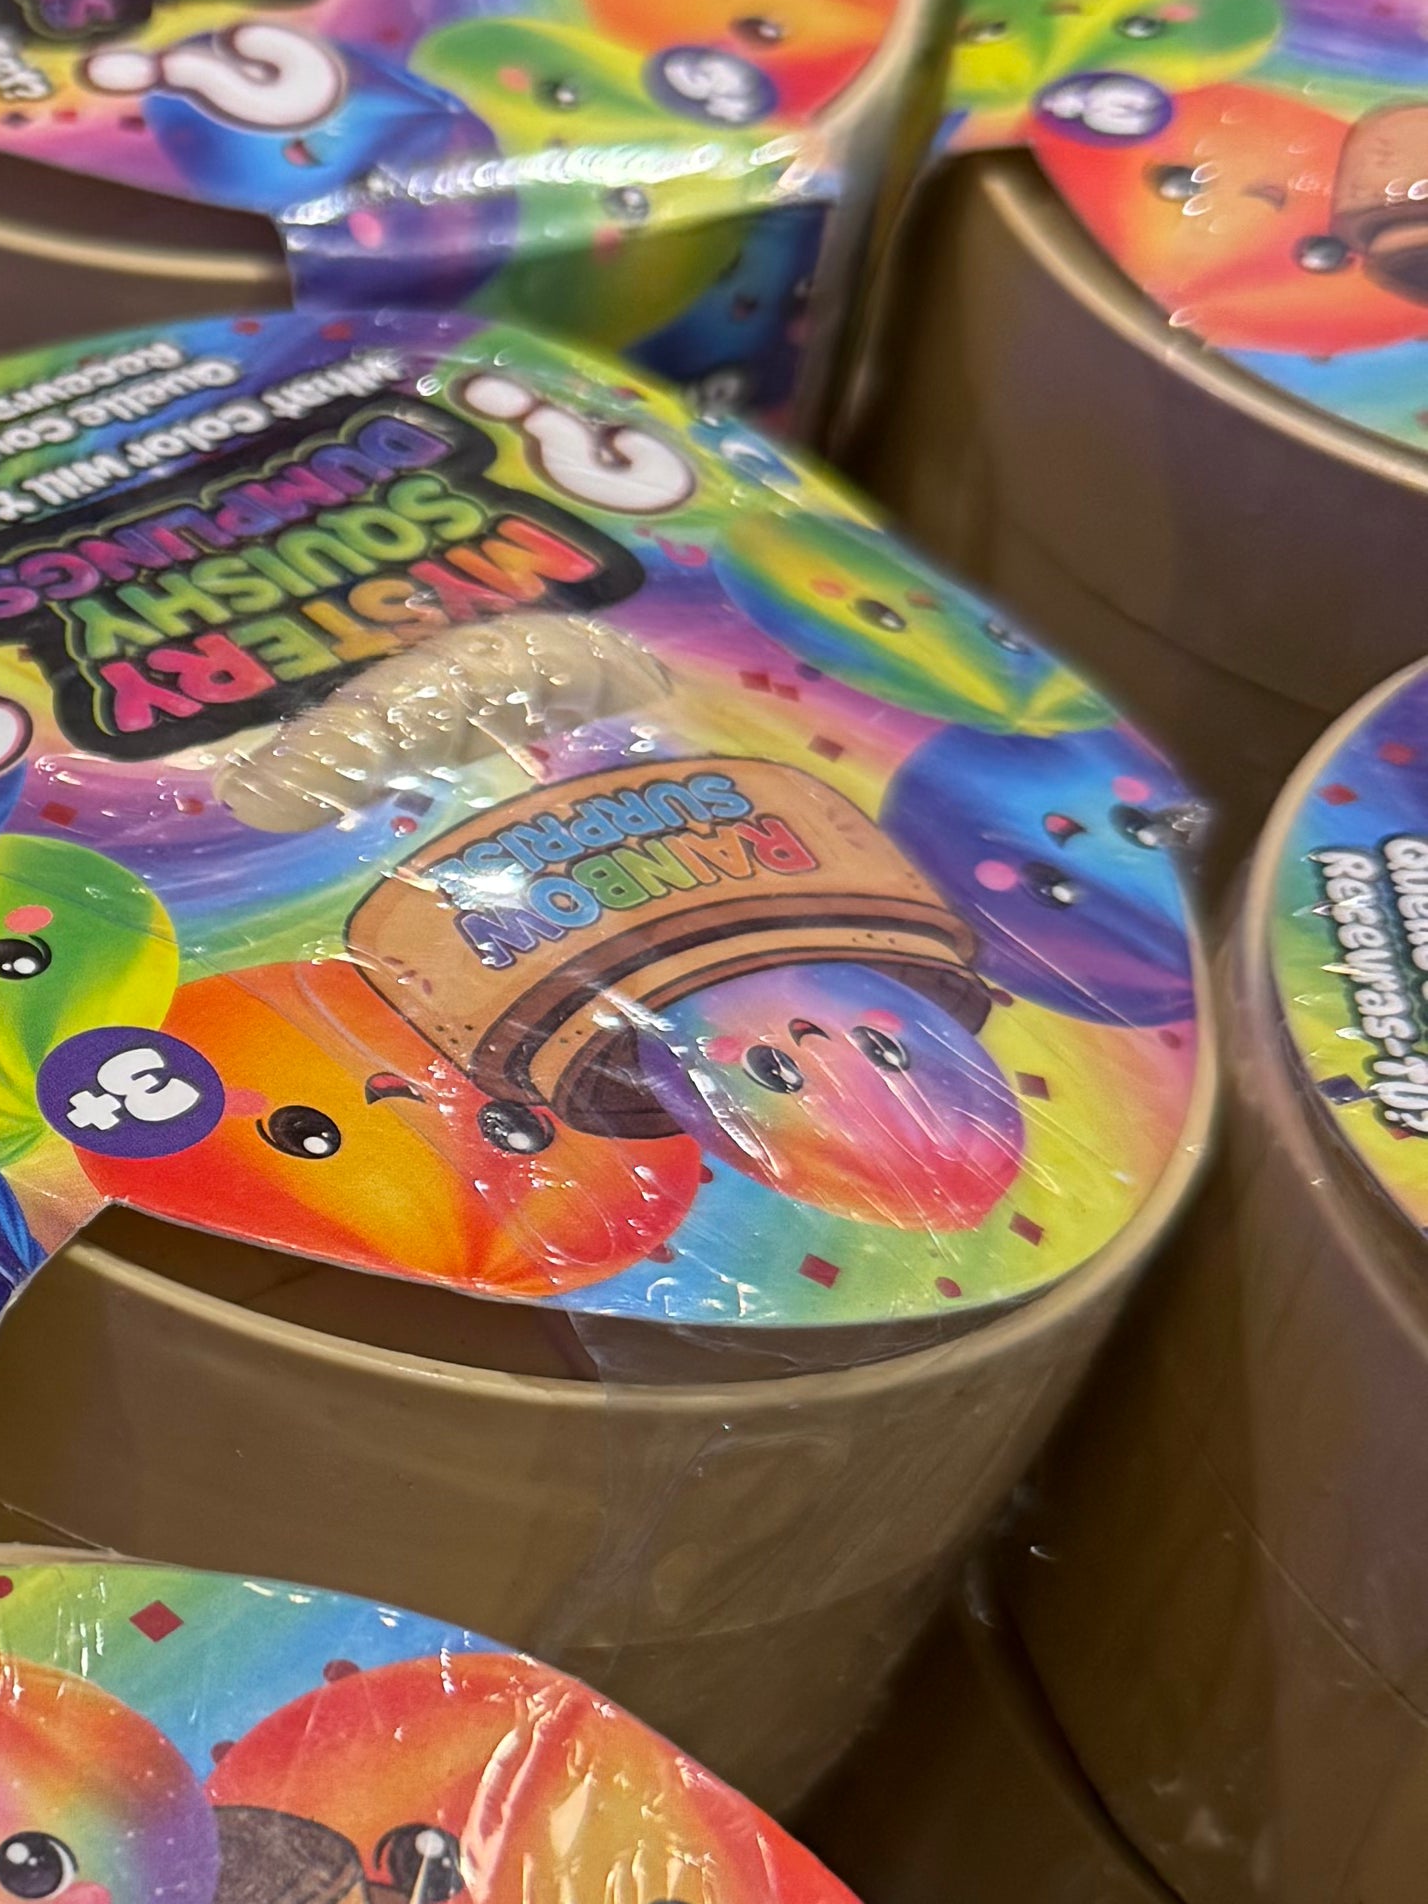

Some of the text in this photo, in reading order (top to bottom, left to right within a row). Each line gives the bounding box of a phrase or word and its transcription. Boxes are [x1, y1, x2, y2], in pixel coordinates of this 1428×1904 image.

[76, 360, 239, 423] Quelle
[128, 406, 267, 469] Color
[25, 455, 129, 502] Will
[75, 476, 484, 658] SQUISHY
[100, 519, 600, 731] MYSTERY
[460, 815, 818, 969] RAINBOW
[65, 1048, 200, 1128] 3+
